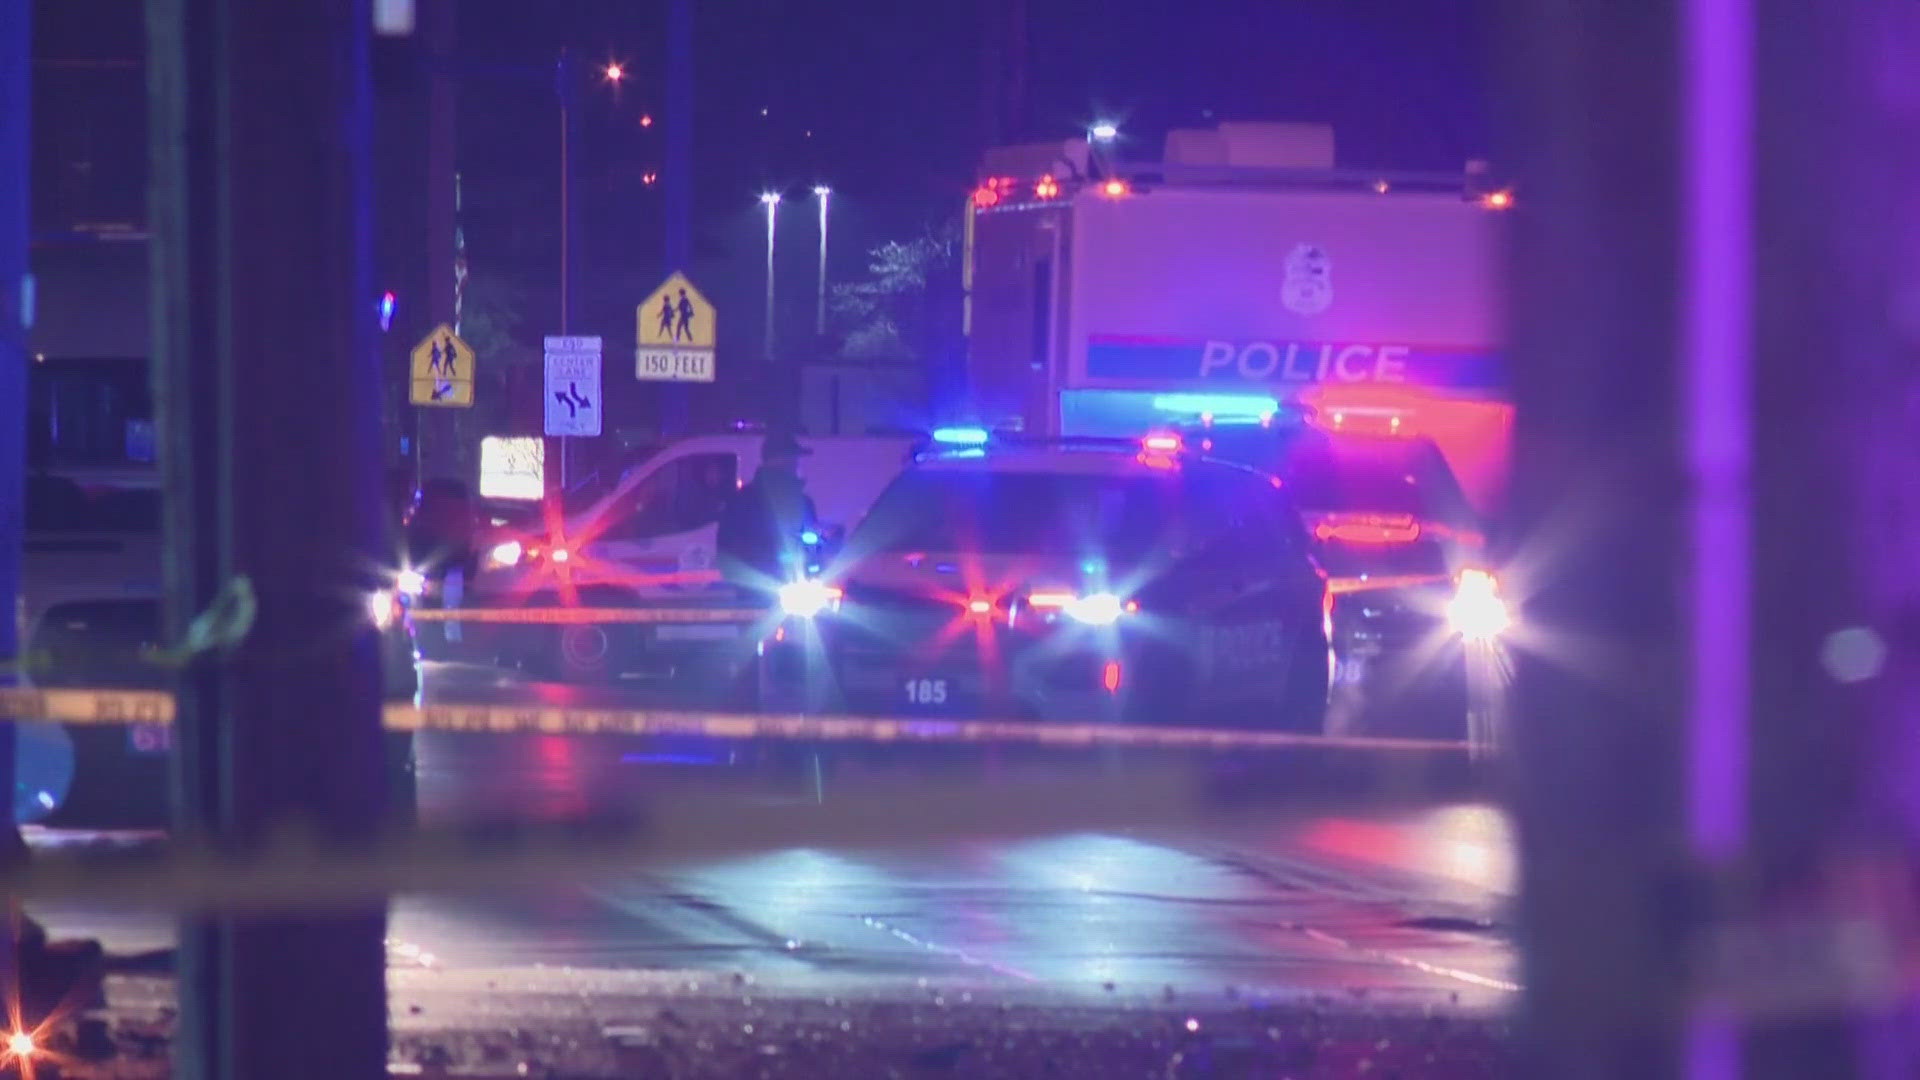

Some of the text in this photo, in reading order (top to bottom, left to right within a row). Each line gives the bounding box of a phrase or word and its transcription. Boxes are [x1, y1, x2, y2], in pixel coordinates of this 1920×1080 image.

[645, 355, 705, 375] 150 FEET
[1199, 340, 1409, 382] POLICE
[904, 679, 948, 704] 185
